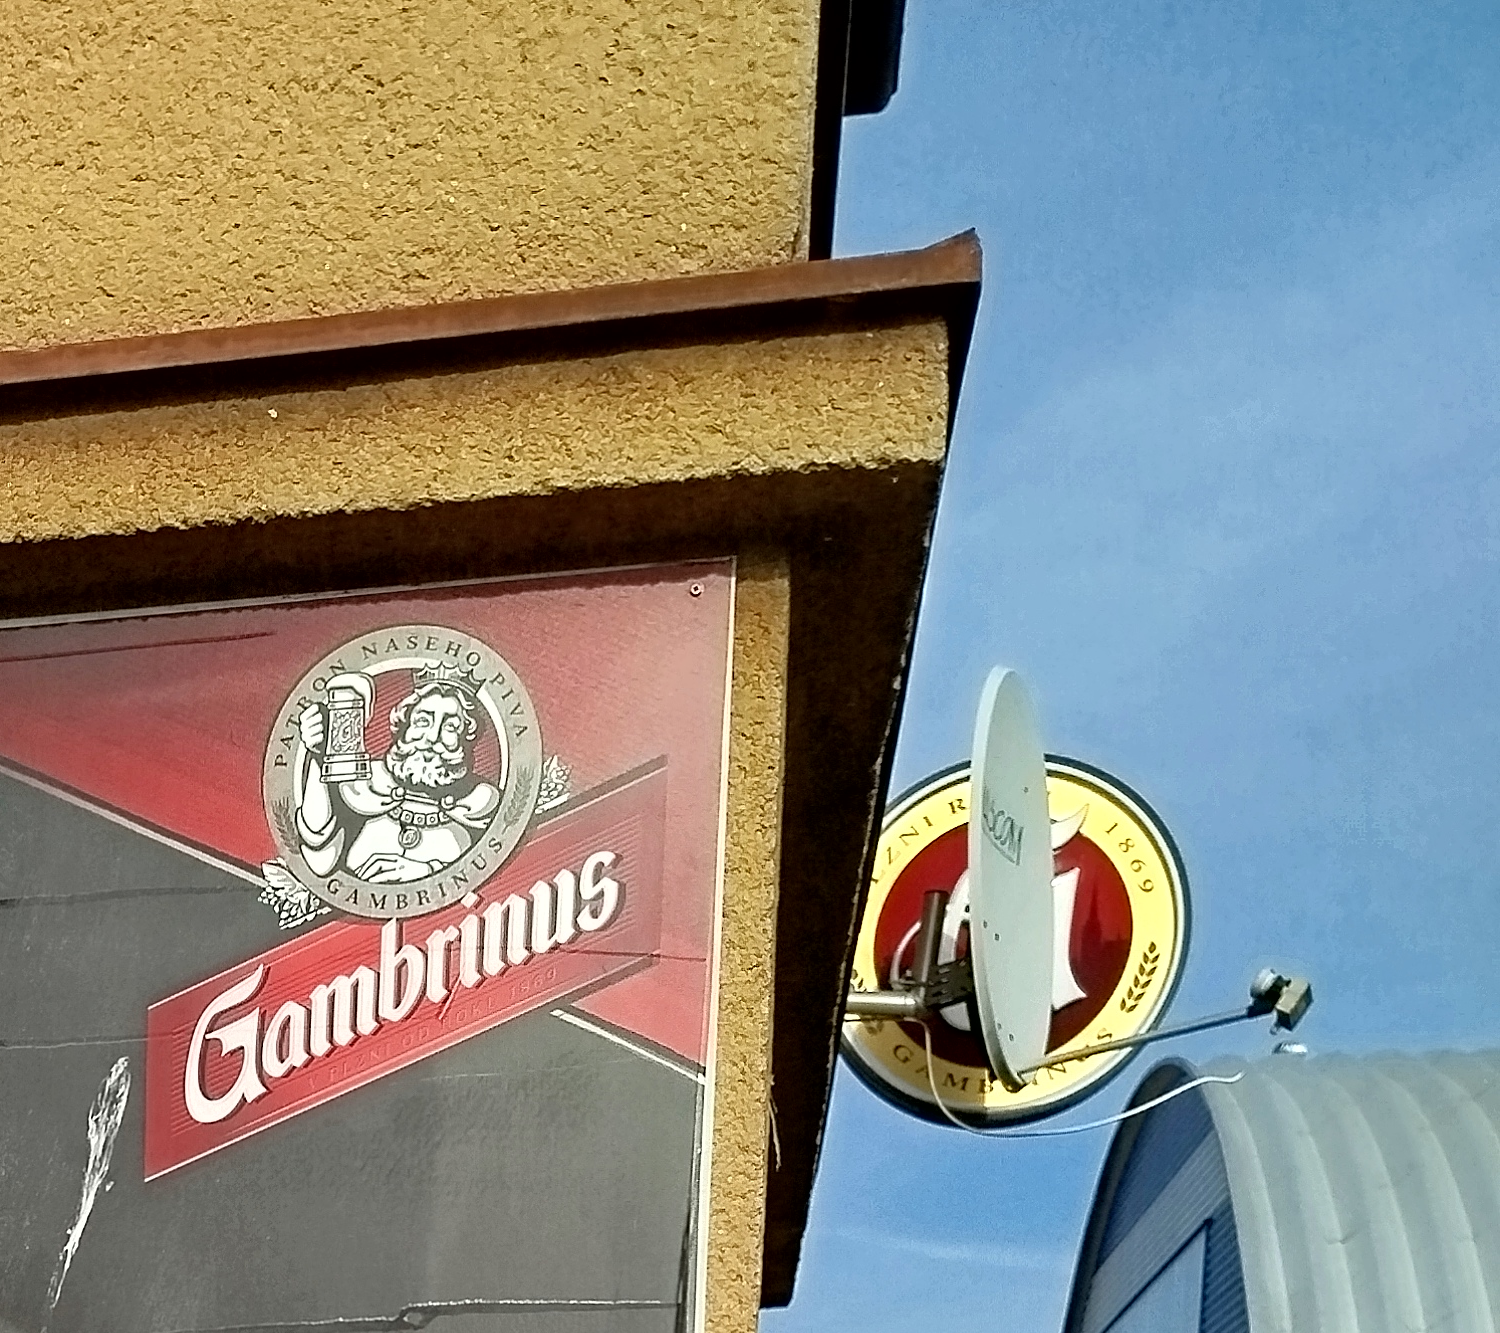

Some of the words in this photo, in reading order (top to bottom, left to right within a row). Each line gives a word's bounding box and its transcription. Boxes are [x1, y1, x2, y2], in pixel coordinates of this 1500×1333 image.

[489, 673, 529, 738] PIVA
[326, 837, 503, 910] GAMBRINUS
[1105, 822, 1155, 894] 1869
[184, 850, 623, 1123] Gambrinus
